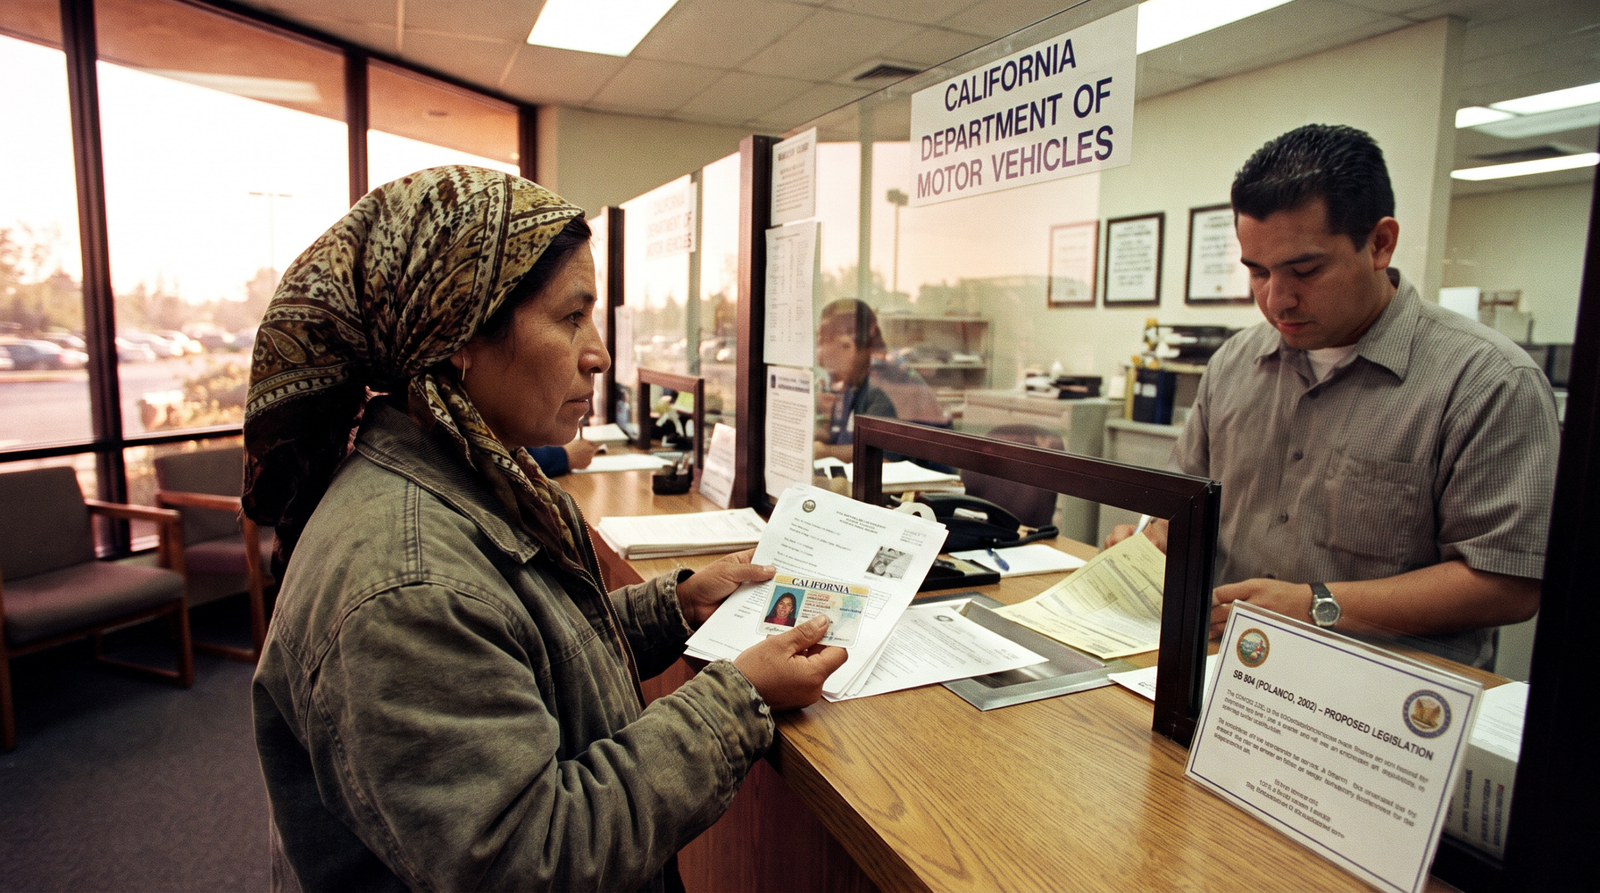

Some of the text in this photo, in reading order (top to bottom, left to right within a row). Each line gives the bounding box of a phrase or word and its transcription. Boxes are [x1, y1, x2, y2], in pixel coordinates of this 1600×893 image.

[945, 38, 1077, 112] CALIFORNIA
[921, 76, 1113, 162] DEPARTMENT OF
[917, 125, 1114, 199] MOTOR VEHICLES
[791, 578, 850, 594] CALIFORNIA
[1233, 669, 1243, 680] SB
[1243, 674, 1256, 686] 804
[1255, 679, 1296, 704] (POLANCO,
[1297, 696, 1317, 713] 2002)
[1324, 707, 1371, 734] PROPOSED
[1371, 727, 1434, 761] LEGISLATION
